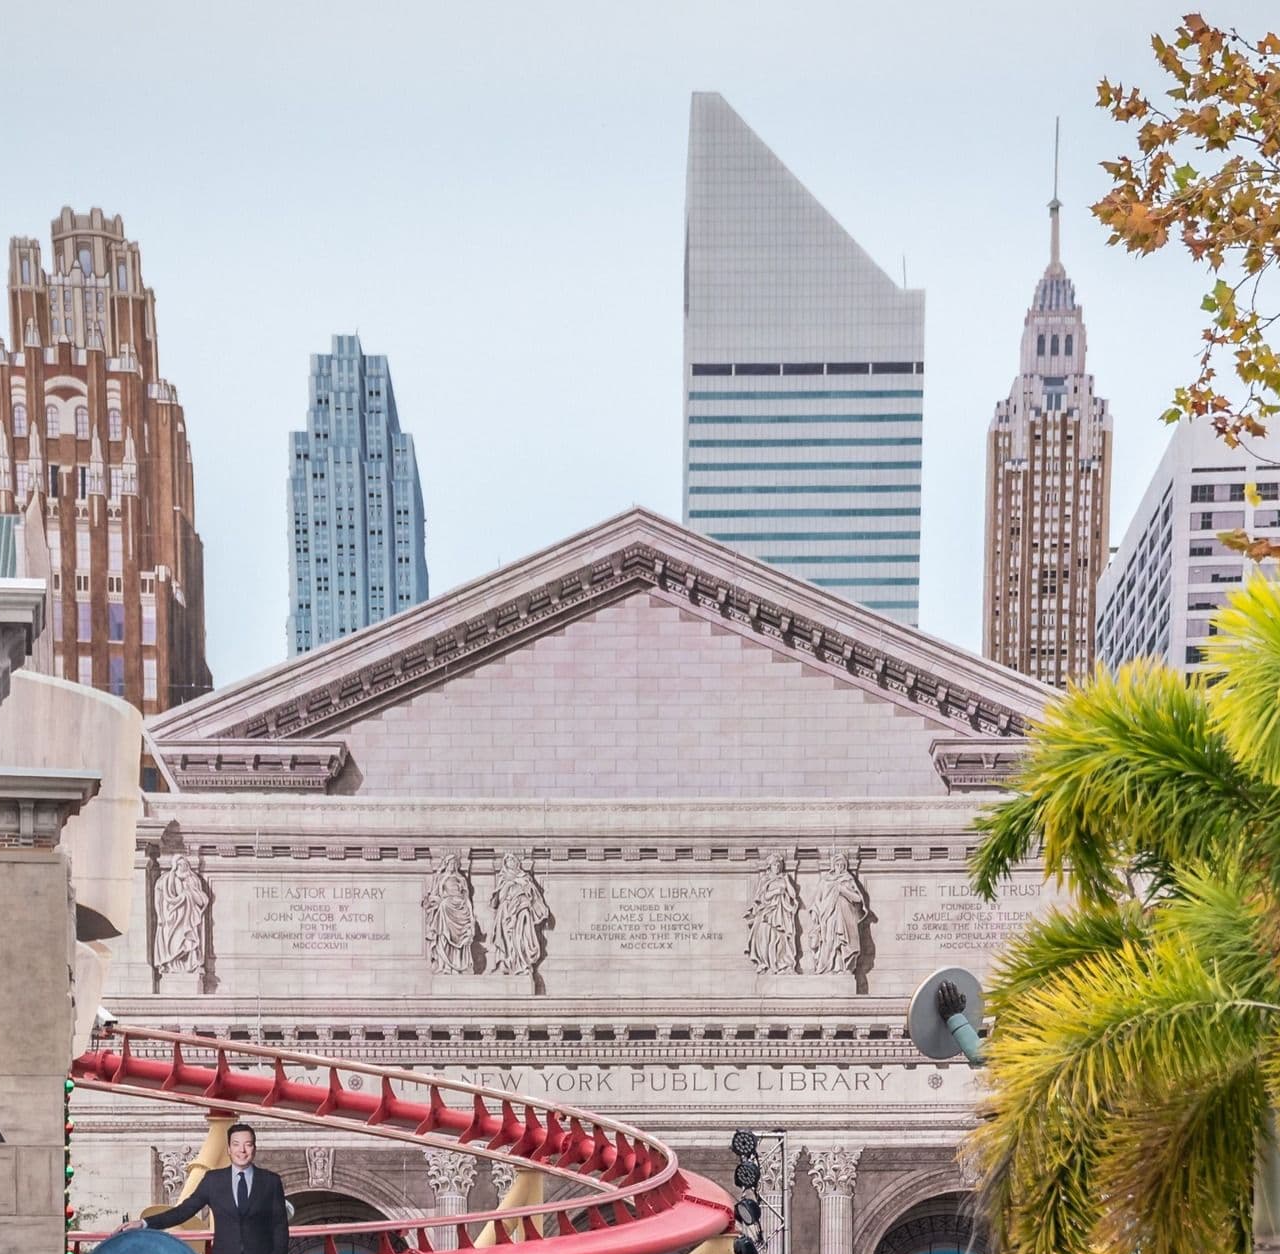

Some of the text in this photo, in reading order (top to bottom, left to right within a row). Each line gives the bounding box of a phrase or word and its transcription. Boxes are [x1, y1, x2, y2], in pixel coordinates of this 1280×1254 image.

[253, 887, 386, 899] THE ASTOR LIBRARY
[580, 887, 714, 899] THE LENOX LIBRARY
[902, 884, 1041, 897] THE TILD TRUST
[290, 904, 330, 912] FOUNDED
[264, 913, 374, 922] JOHN JACOB ASTOR
[604, 913, 690, 922] JAMES LENOX
[912, 912, 952, 922] SAMUEL
[959, 911, 992, 921] JONES
[300, 923, 337, 931] FOR THE
[570, 933, 626, 941] LITERATURE
[895, 933, 931, 941] SCIENCE
[956, 932, 996, 940] POPULAR
[461, 1072, 523, 1092] NEW
[541, 1072, 614, 1092] YORK
[631, 1072, 741, 1092] PUBLIC
[757, 1072, 893, 1092] LIBRARY
